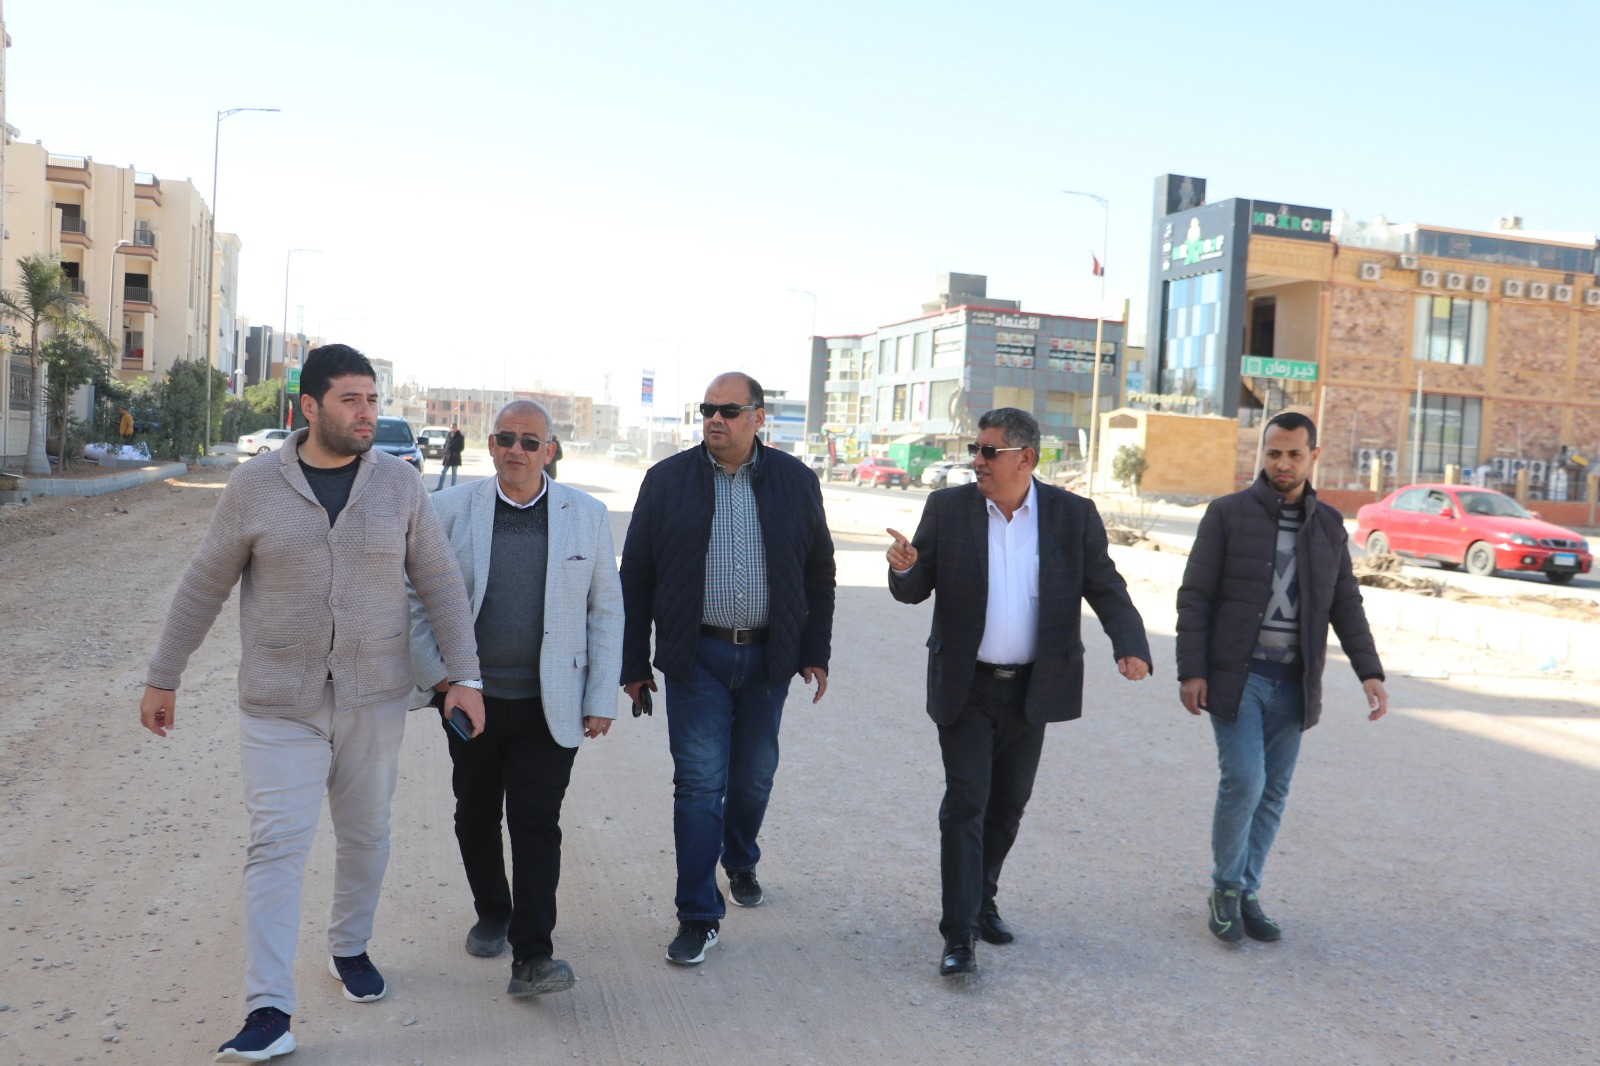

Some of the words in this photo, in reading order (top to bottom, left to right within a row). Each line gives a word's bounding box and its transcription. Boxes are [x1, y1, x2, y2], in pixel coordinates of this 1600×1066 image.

[1265, 361, 1291, 378] زمان
[1292, 364, 1315, 378] خير
[1127, 390, 1197, 406] Primavera
